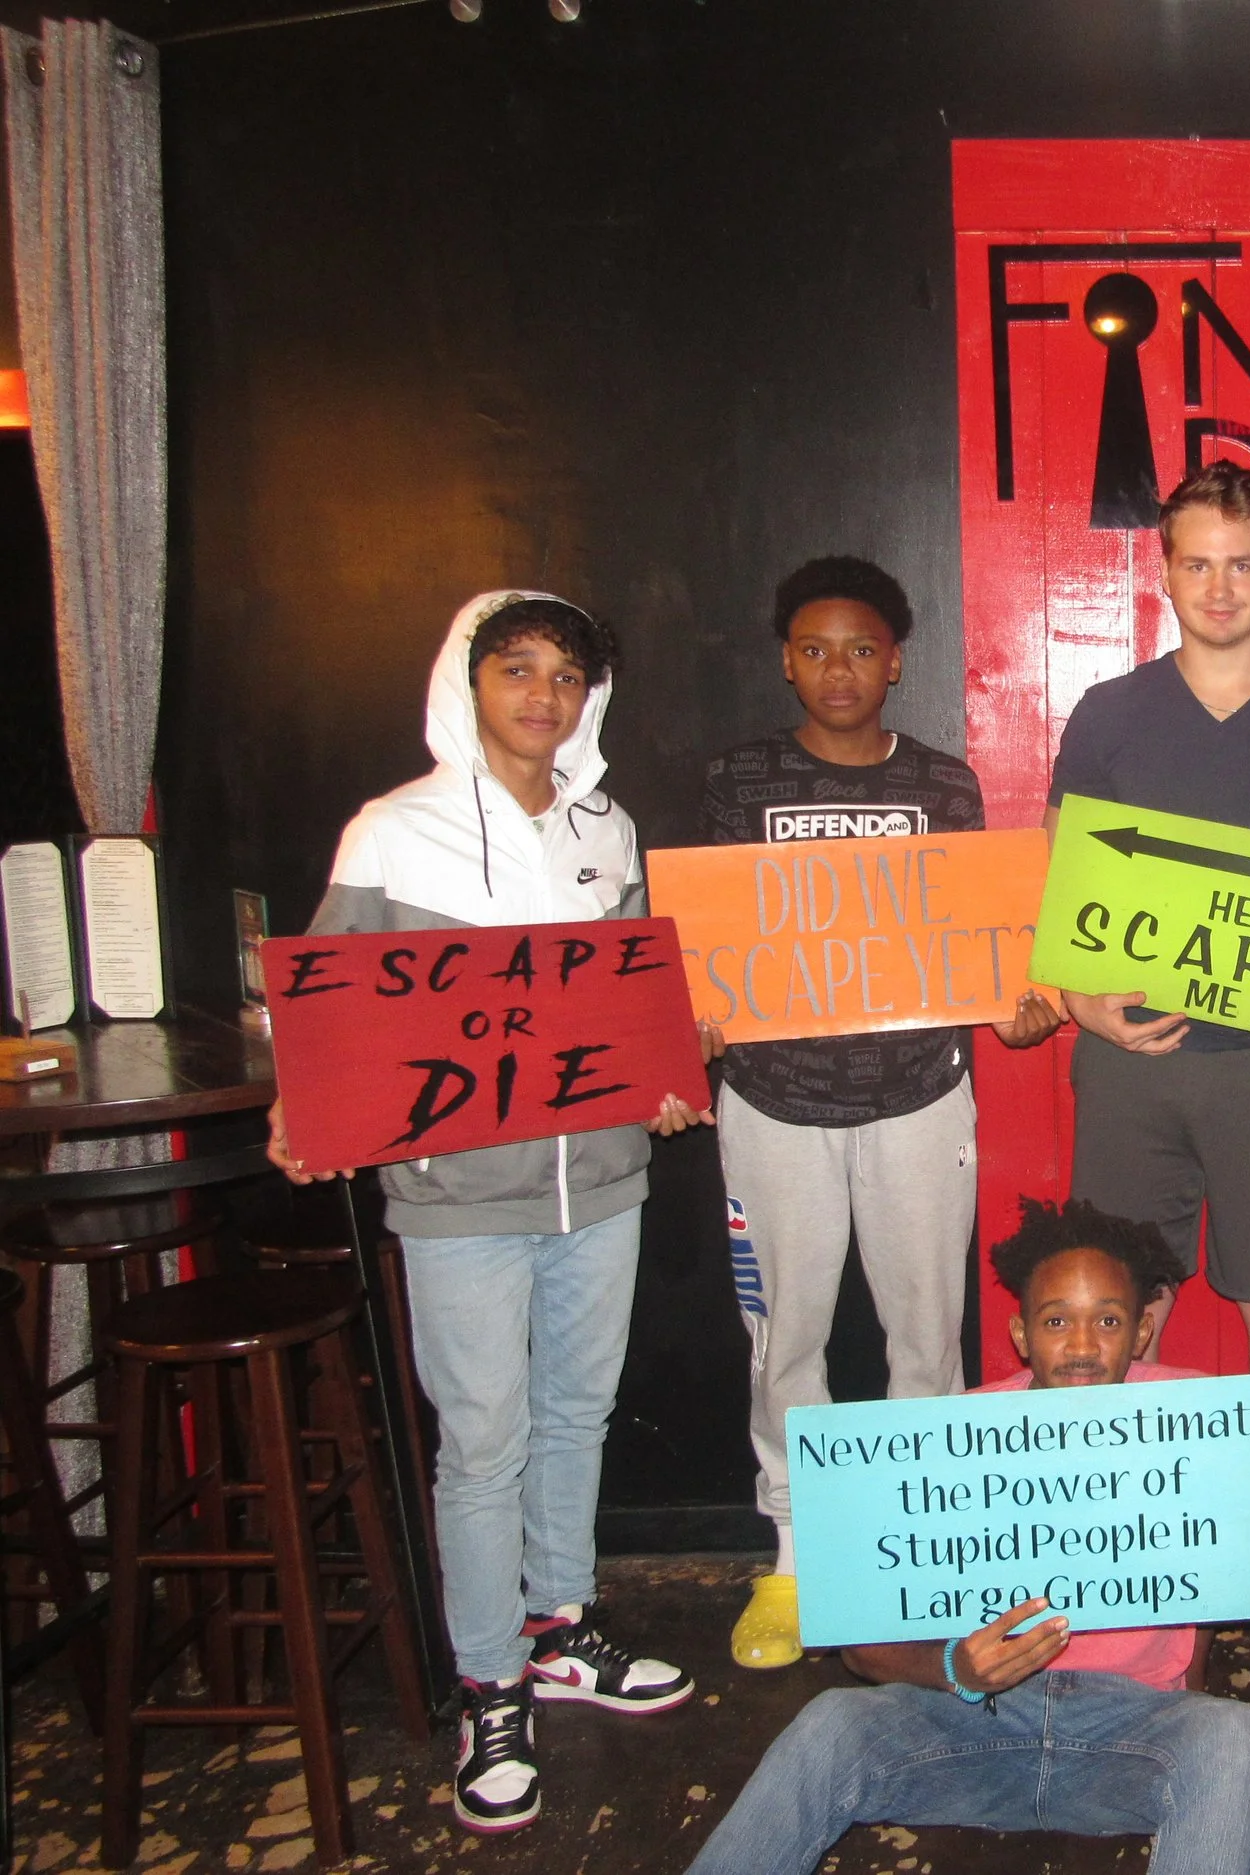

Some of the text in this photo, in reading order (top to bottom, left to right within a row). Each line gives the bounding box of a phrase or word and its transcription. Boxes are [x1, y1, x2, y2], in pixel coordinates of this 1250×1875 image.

[812, 777, 867, 800] Block
[775, 814, 909, 840] DEFEND AND
[580, 867, 598, 877] NIKE
[755, 848, 951, 936] DID WE
[281, 935, 670, 1000] ESCAPE
[1184, 978, 1241, 1018] ME
[461, 1007, 536, 1040] OR
[848, 1053, 882, 1067] TRIPLE
[848, 1065, 884, 1078] DOUBLE
[369, 1044, 640, 1157] DIE
[798, 1432, 933, 1469] Never
[897, 1457, 1190, 1514] the Power of
[877, 1512, 1217, 1574] Stupid People in
[900, 1571, 1199, 1625] Large Groups
